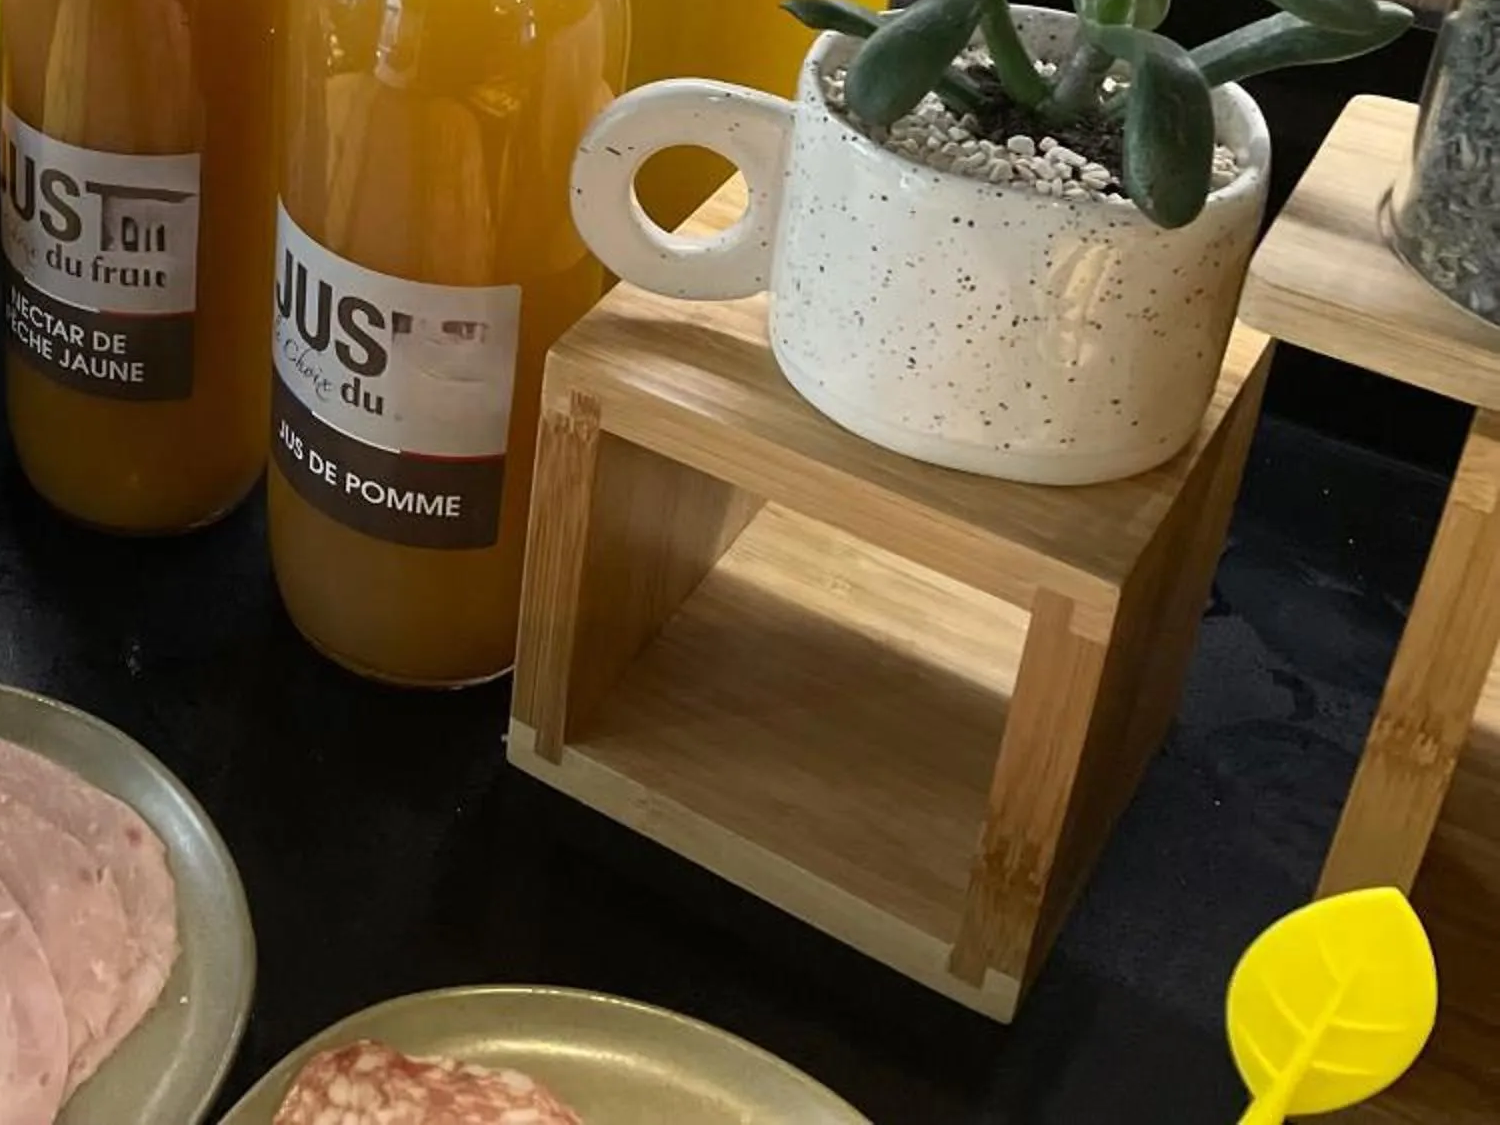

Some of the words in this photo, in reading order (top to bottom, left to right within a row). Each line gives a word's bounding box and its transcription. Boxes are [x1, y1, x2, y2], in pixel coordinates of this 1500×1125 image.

[45, 243, 82, 277] du
[11, 286, 85, 347] NECTAR
[92, 331, 128, 355] DE
[58, 348, 145, 382] JAUNE
[341, 377, 384, 416] du
[279, 419, 304, 460] JUS
[308, 449, 338, 485] DE
[345, 472, 461, 517] POMME
